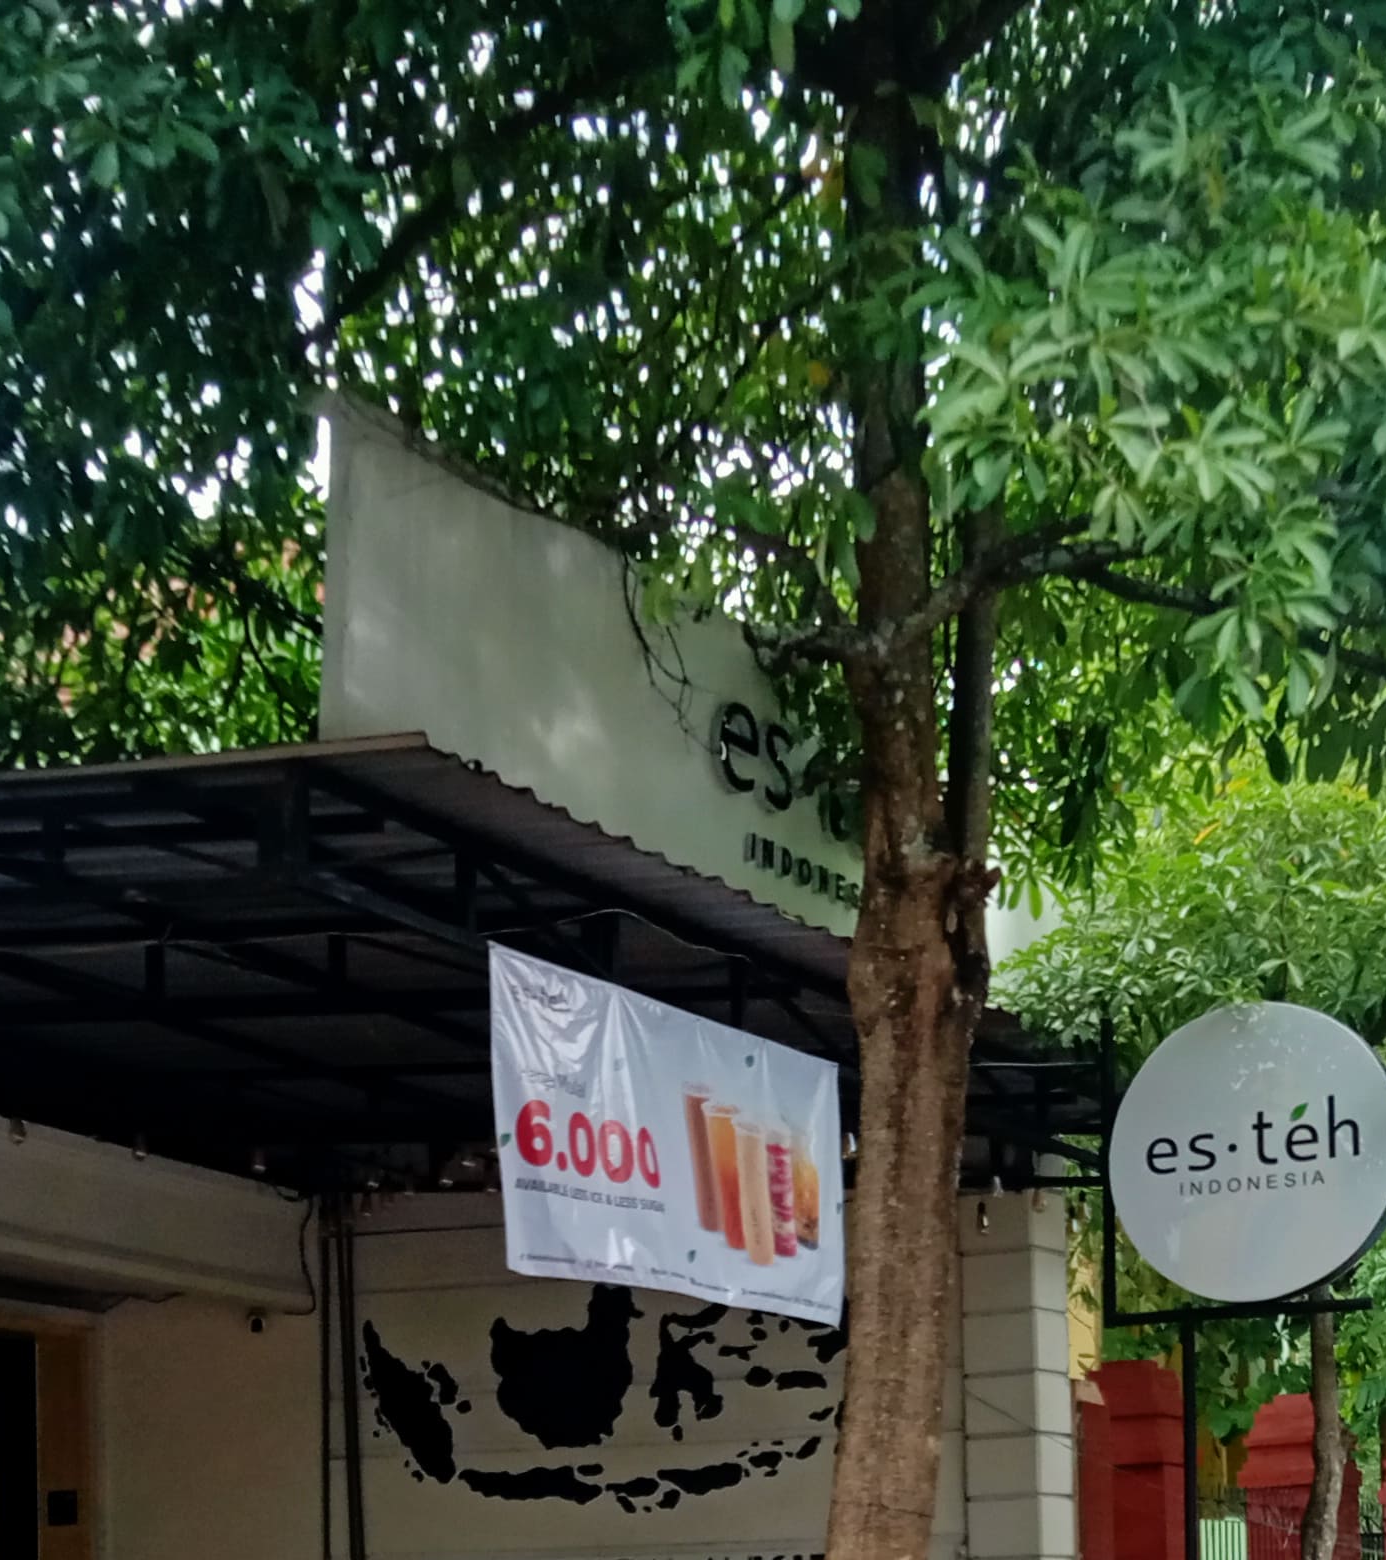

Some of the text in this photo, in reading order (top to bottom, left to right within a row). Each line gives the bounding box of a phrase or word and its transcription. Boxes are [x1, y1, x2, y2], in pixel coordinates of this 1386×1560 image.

[743, 831, 863, 909] INDONES
[516, 1099, 662, 1189] 6.000
[1179, 1169, 1326, 1196] INDONESIA
